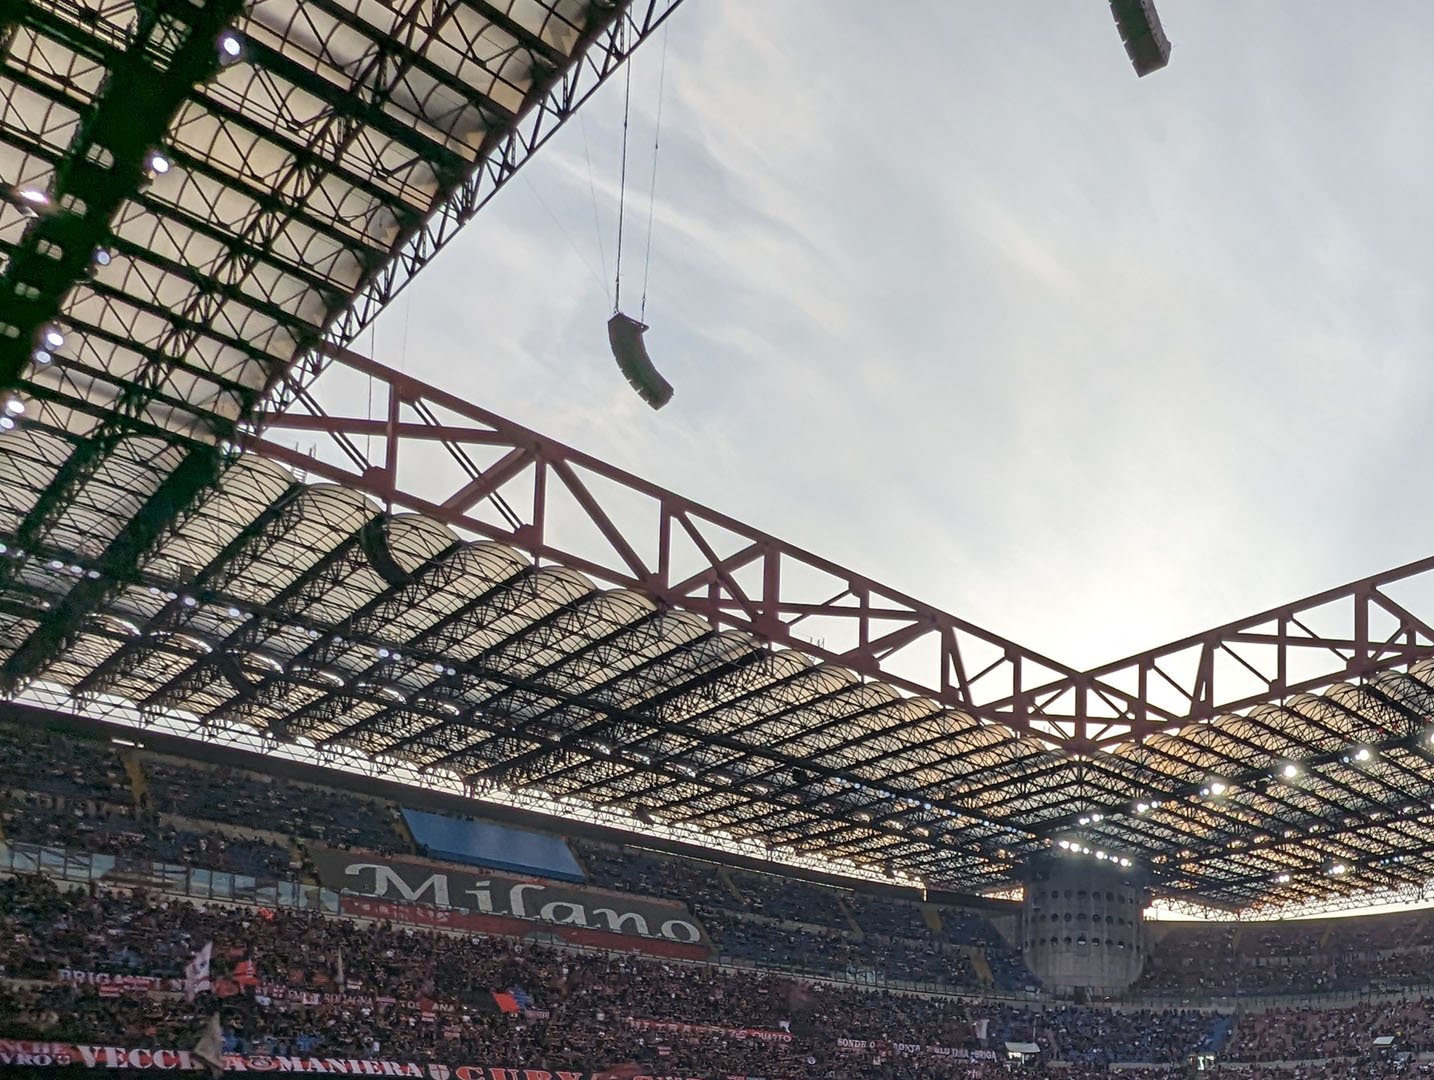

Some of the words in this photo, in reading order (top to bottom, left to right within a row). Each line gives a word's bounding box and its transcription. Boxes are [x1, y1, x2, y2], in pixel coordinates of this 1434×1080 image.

[344, 863, 701, 943] Milano
[77, 1046, 247, 1071] VECCA
[275, 1055, 424, 1079] MANIERA
